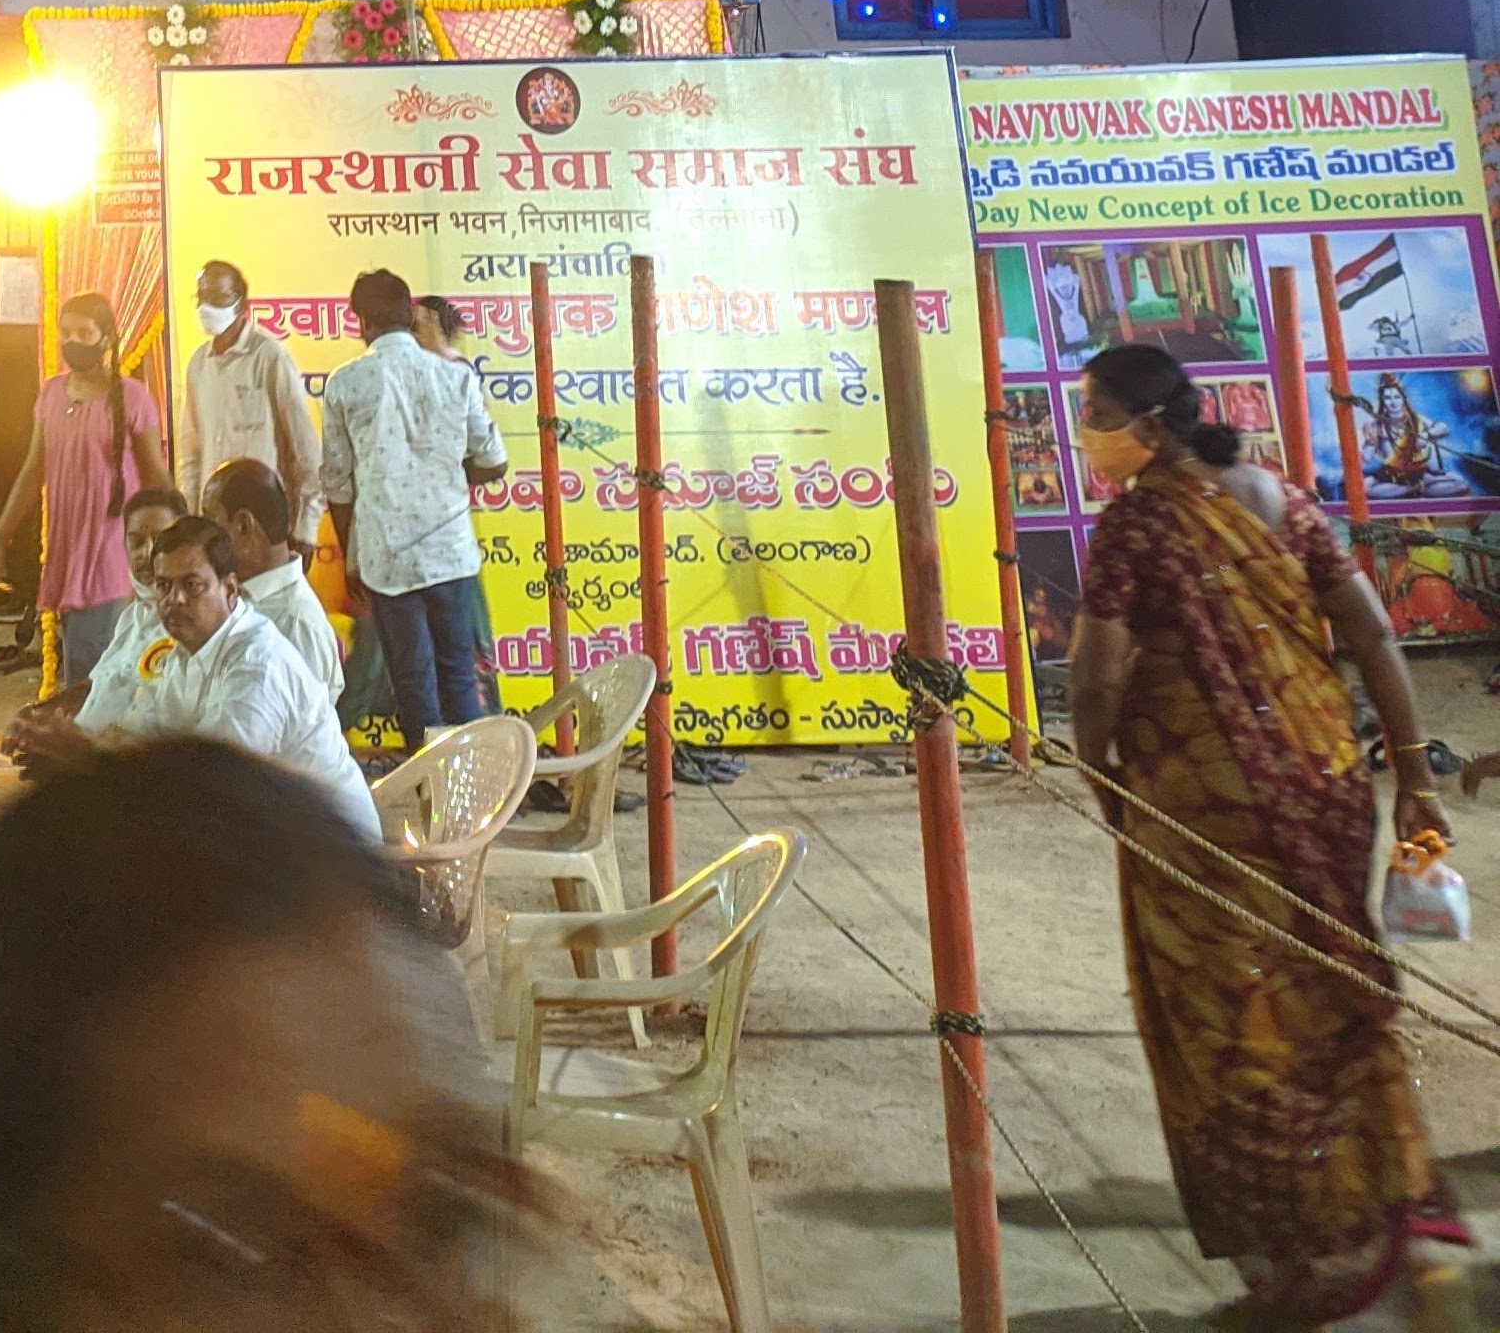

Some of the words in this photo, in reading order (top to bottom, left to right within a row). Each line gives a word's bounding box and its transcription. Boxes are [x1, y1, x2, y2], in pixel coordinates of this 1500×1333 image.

[968, 99, 1148, 141] NAVYUVAK
[1156, 93, 1292, 135] GANESH
[1300, 88, 1442, 130] MANDAL
[205, 134, 482, 197] राजस्थानी
[497, 133, 612, 193] सेवा
[629, 146, 804, 189] समाज
[823, 127, 918, 187] संघ
[1029, 152, 1217, 190] నవయువక్
[1223, 146, 1322, 183] గణేష్
[1327, 140, 1456, 176] మండల్
[328, 212, 439, 237] राजस्थान
[1029, 197, 1088, 223] New
[1097, 190, 1216, 222] Concept
[1224, 186, 1252, 214] of
[1258, 188, 1301, 213] Ice
[1310, 184, 1465, 212] Decoration
[461, 253, 528, 282] द्वारा
[703, 367, 827, 404] करता
[829, 349, 882, 406] है.
[682, 614, 823, 682] గణేష్
[673, 700, 791, 745] స్వాగతం
